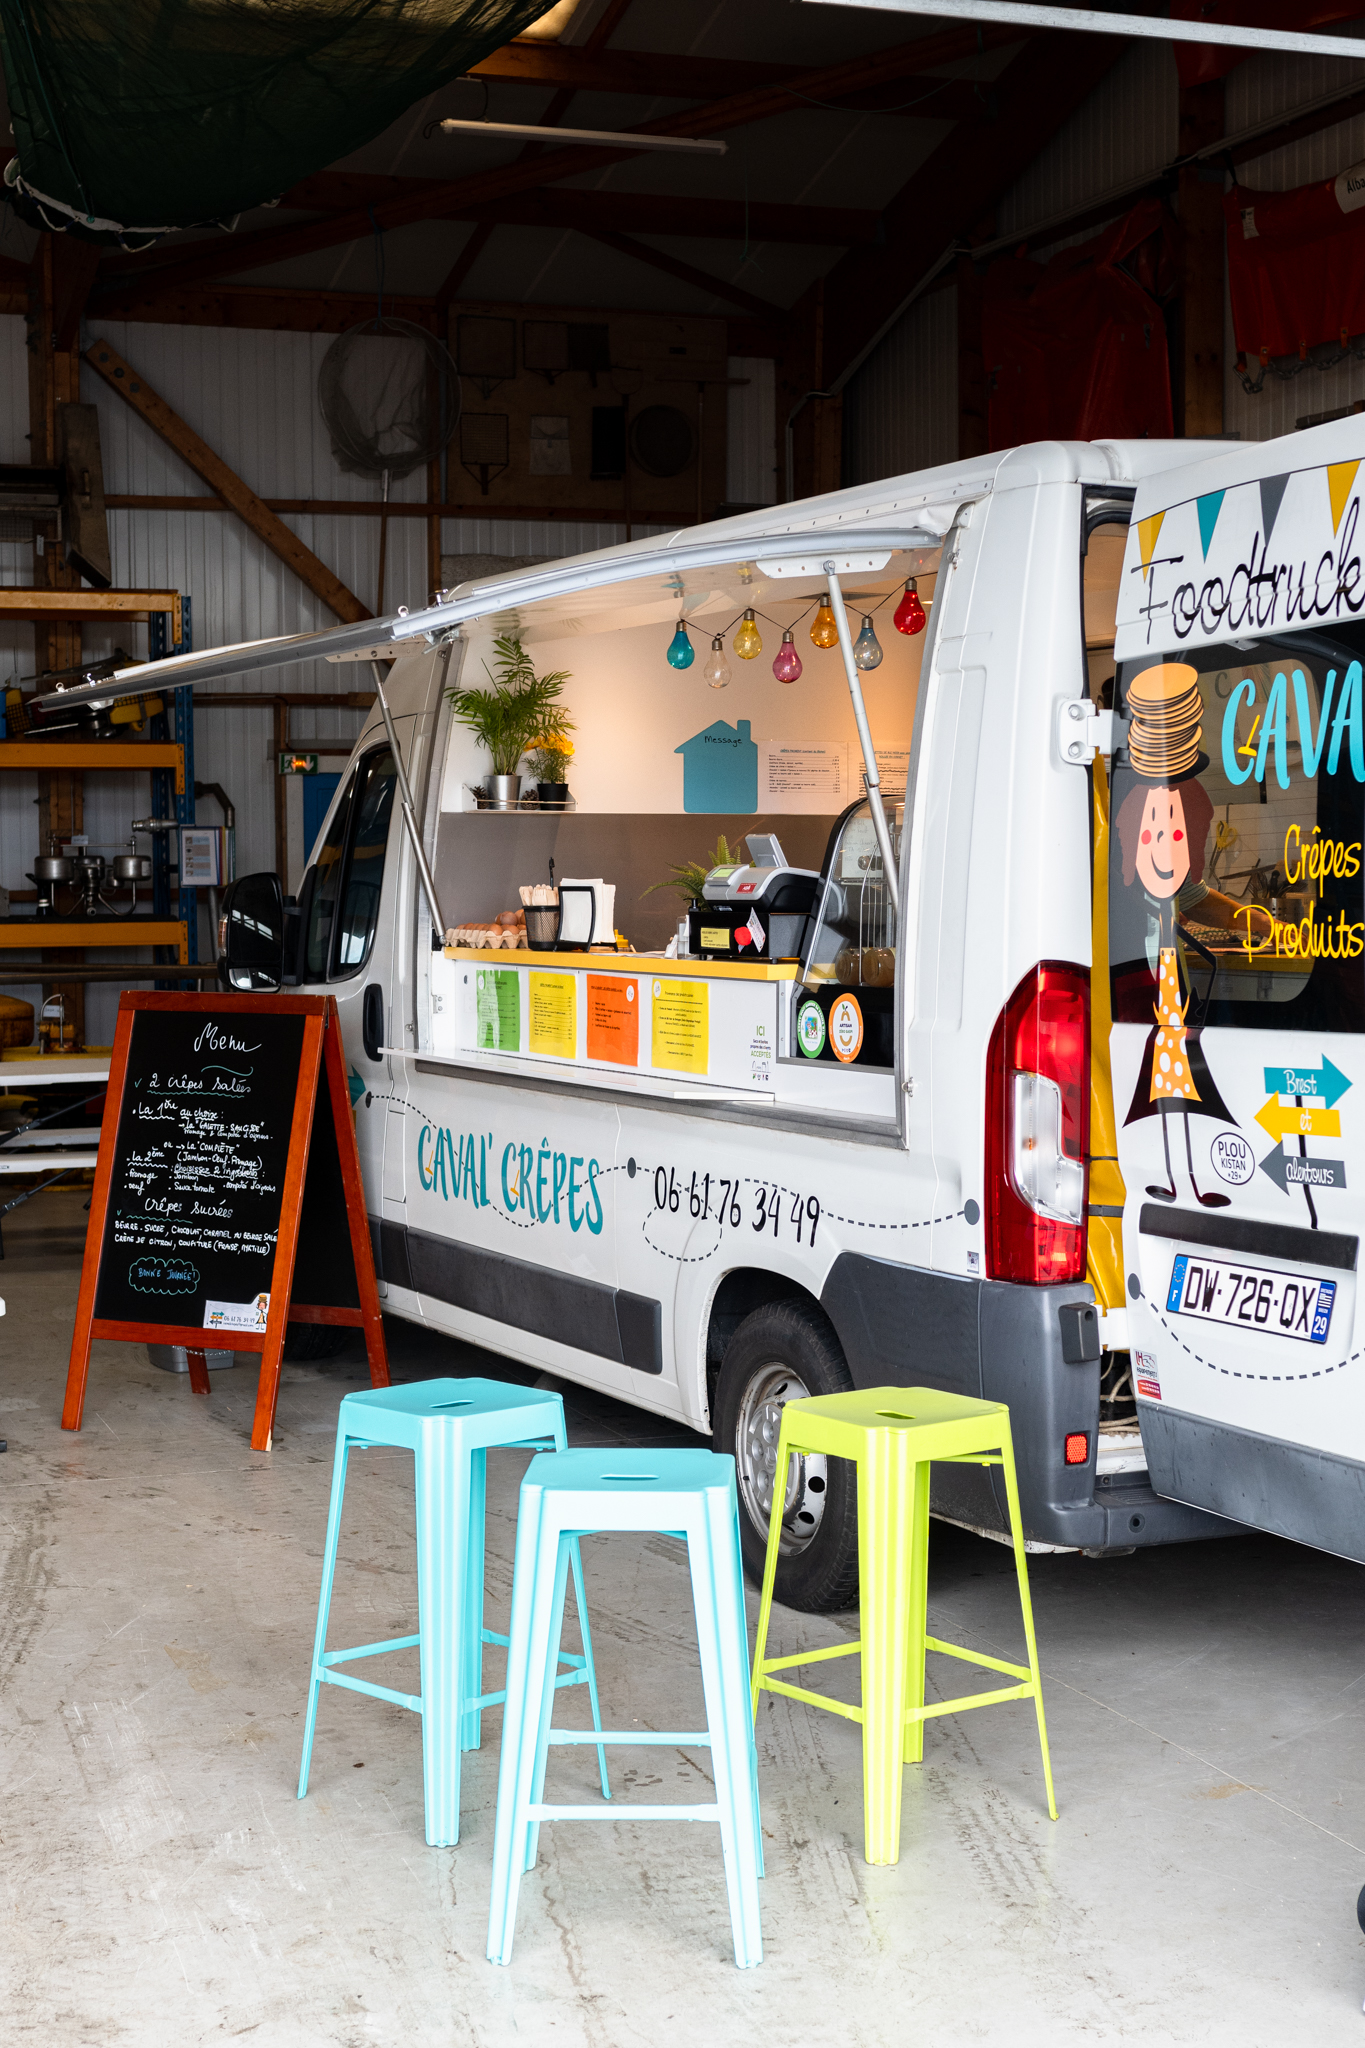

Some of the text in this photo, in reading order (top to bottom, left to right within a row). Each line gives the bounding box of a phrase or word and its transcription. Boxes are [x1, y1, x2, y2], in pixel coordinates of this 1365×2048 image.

[1131, 496, 1365, 645] Foodtruck
[704, 735, 742, 748] Message
[1284, 823, 1362, 898] Crêpes
[1233, 900, 1365, 963] Produits
[193, 1022, 262, 1052] Menu
[756, 1025, 766, 1037] ICI
[149, 1072, 161, 1088] 2
[1283, 1069, 1317, 1094] Brest
[1300, 1108, 1312, 1131] et
[1218, 1140, 1247, 1159] PLOU
[1220, 1157, 1247, 1171] KISTAN
[1285, 1156, 1334, 1184] alentours
[418, 1125, 604, 1235] CAVAL' CRÊPES
[654, 1165, 820, 1248] 06 61 76 34 49
[138, 1267, 161, 1278] BONNE
[1171, 1289, 1178, 1301] F
[1312, 1315, 1328, 1336] 29
